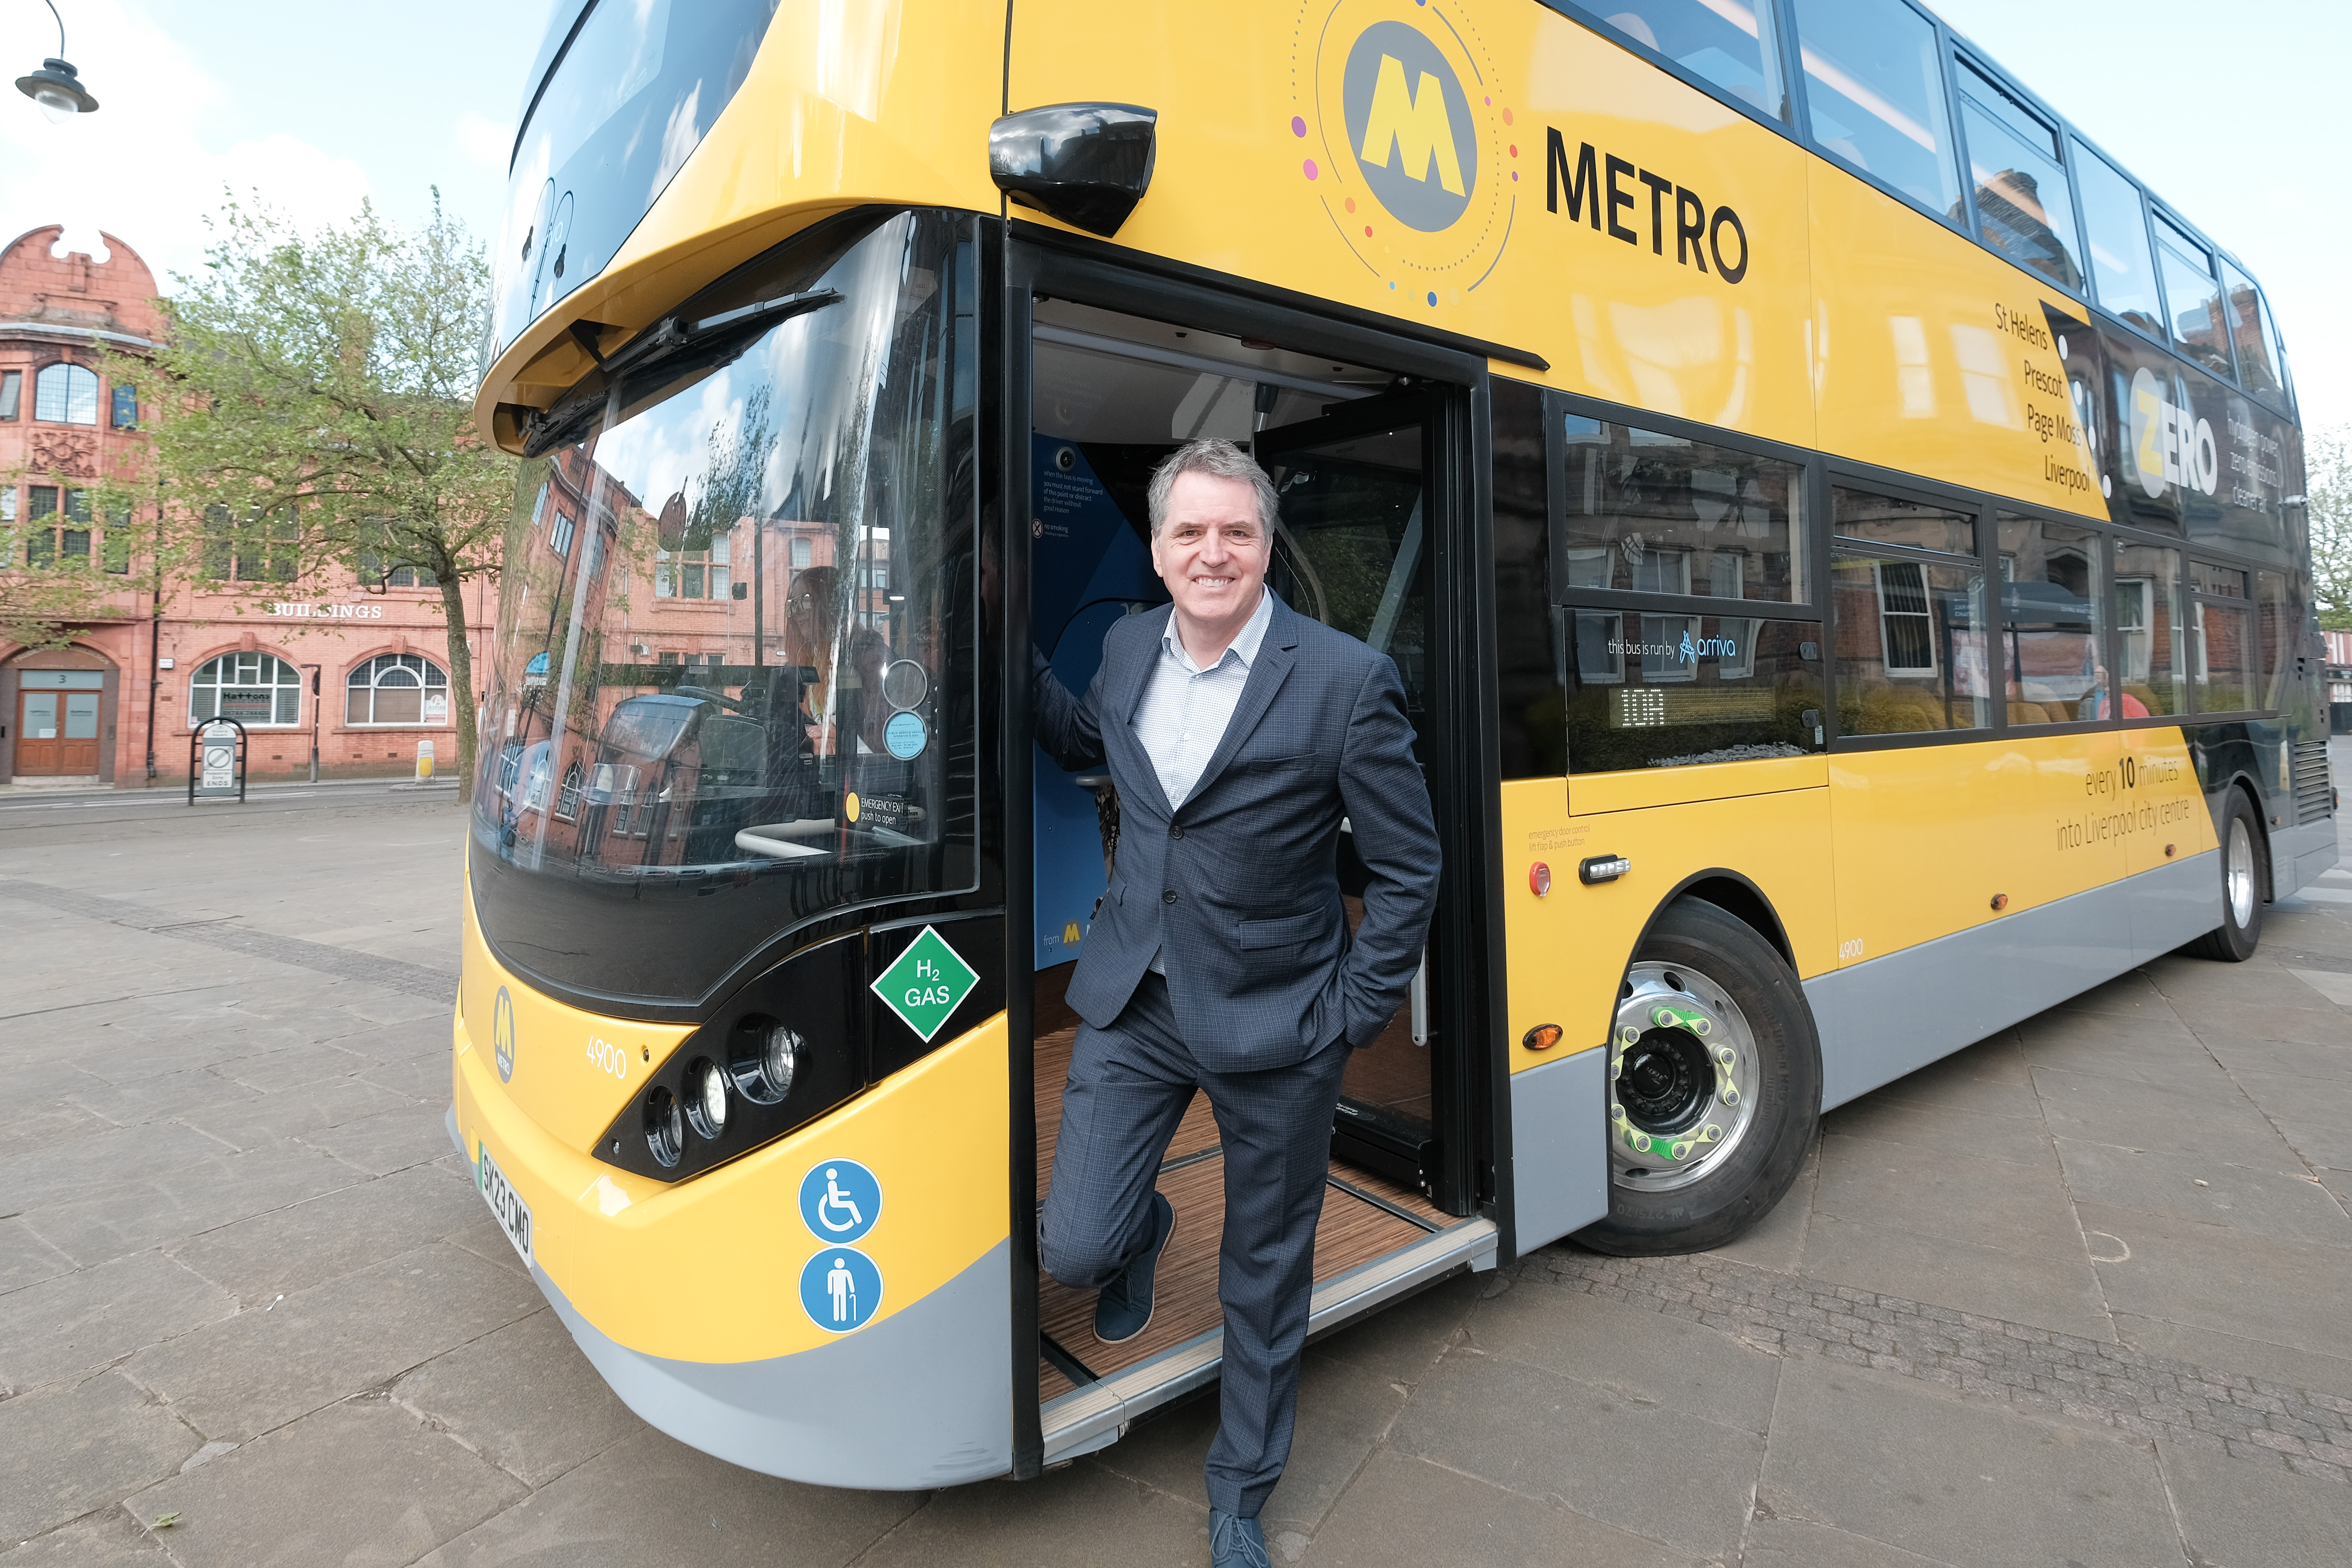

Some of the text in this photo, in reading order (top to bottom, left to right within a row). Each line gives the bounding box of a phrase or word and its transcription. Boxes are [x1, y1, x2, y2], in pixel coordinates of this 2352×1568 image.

[1547, 126, 1748, 284] METRO
[1995, 303, 2047, 350] St Helens
[2024, 359, 2063, 399] Prescot
[2028, 403, 2081, 446] Page Moss
[2137, 388, 2218, 496] ZERO
[2046, 455, 2090, 495] Liverpool
[1050, 525, 1068, 534] smoking
[267, 603, 382, 619] BUILDINGS
[1608, 634, 1736, 660] this bus is run by arriva
[59, 675, 67, 683] 3
[2086, 757, 2178, 801] every 10 minutes
[861, 798, 892, 811] EMERGENCY
[893, 802, 904, 813] EXIT
[861, 810, 874, 822] push
[875, 813, 881, 822] to
[882, 815, 896, 827] open
[2057, 796, 2189, 851] into Liverpool city centre
[1529, 824, 1590, 840] emergency door control
[1538, 841, 1548, 852] flap
[1549, 840, 1553, 849] &
[1554, 839, 1567, 850] push
[1568, 838, 1584, 846] button
[1044, 935, 1059, 946] from
[1839, 938, 1863, 960] 4900
[905, 986, 949, 1007] GAS
[497, 1052, 510, 1075] METRO
[586, 1035, 626, 1079] 4900
[484, 1154, 505, 1219] SK23
[508, 1191, 529, 1254] CMO
